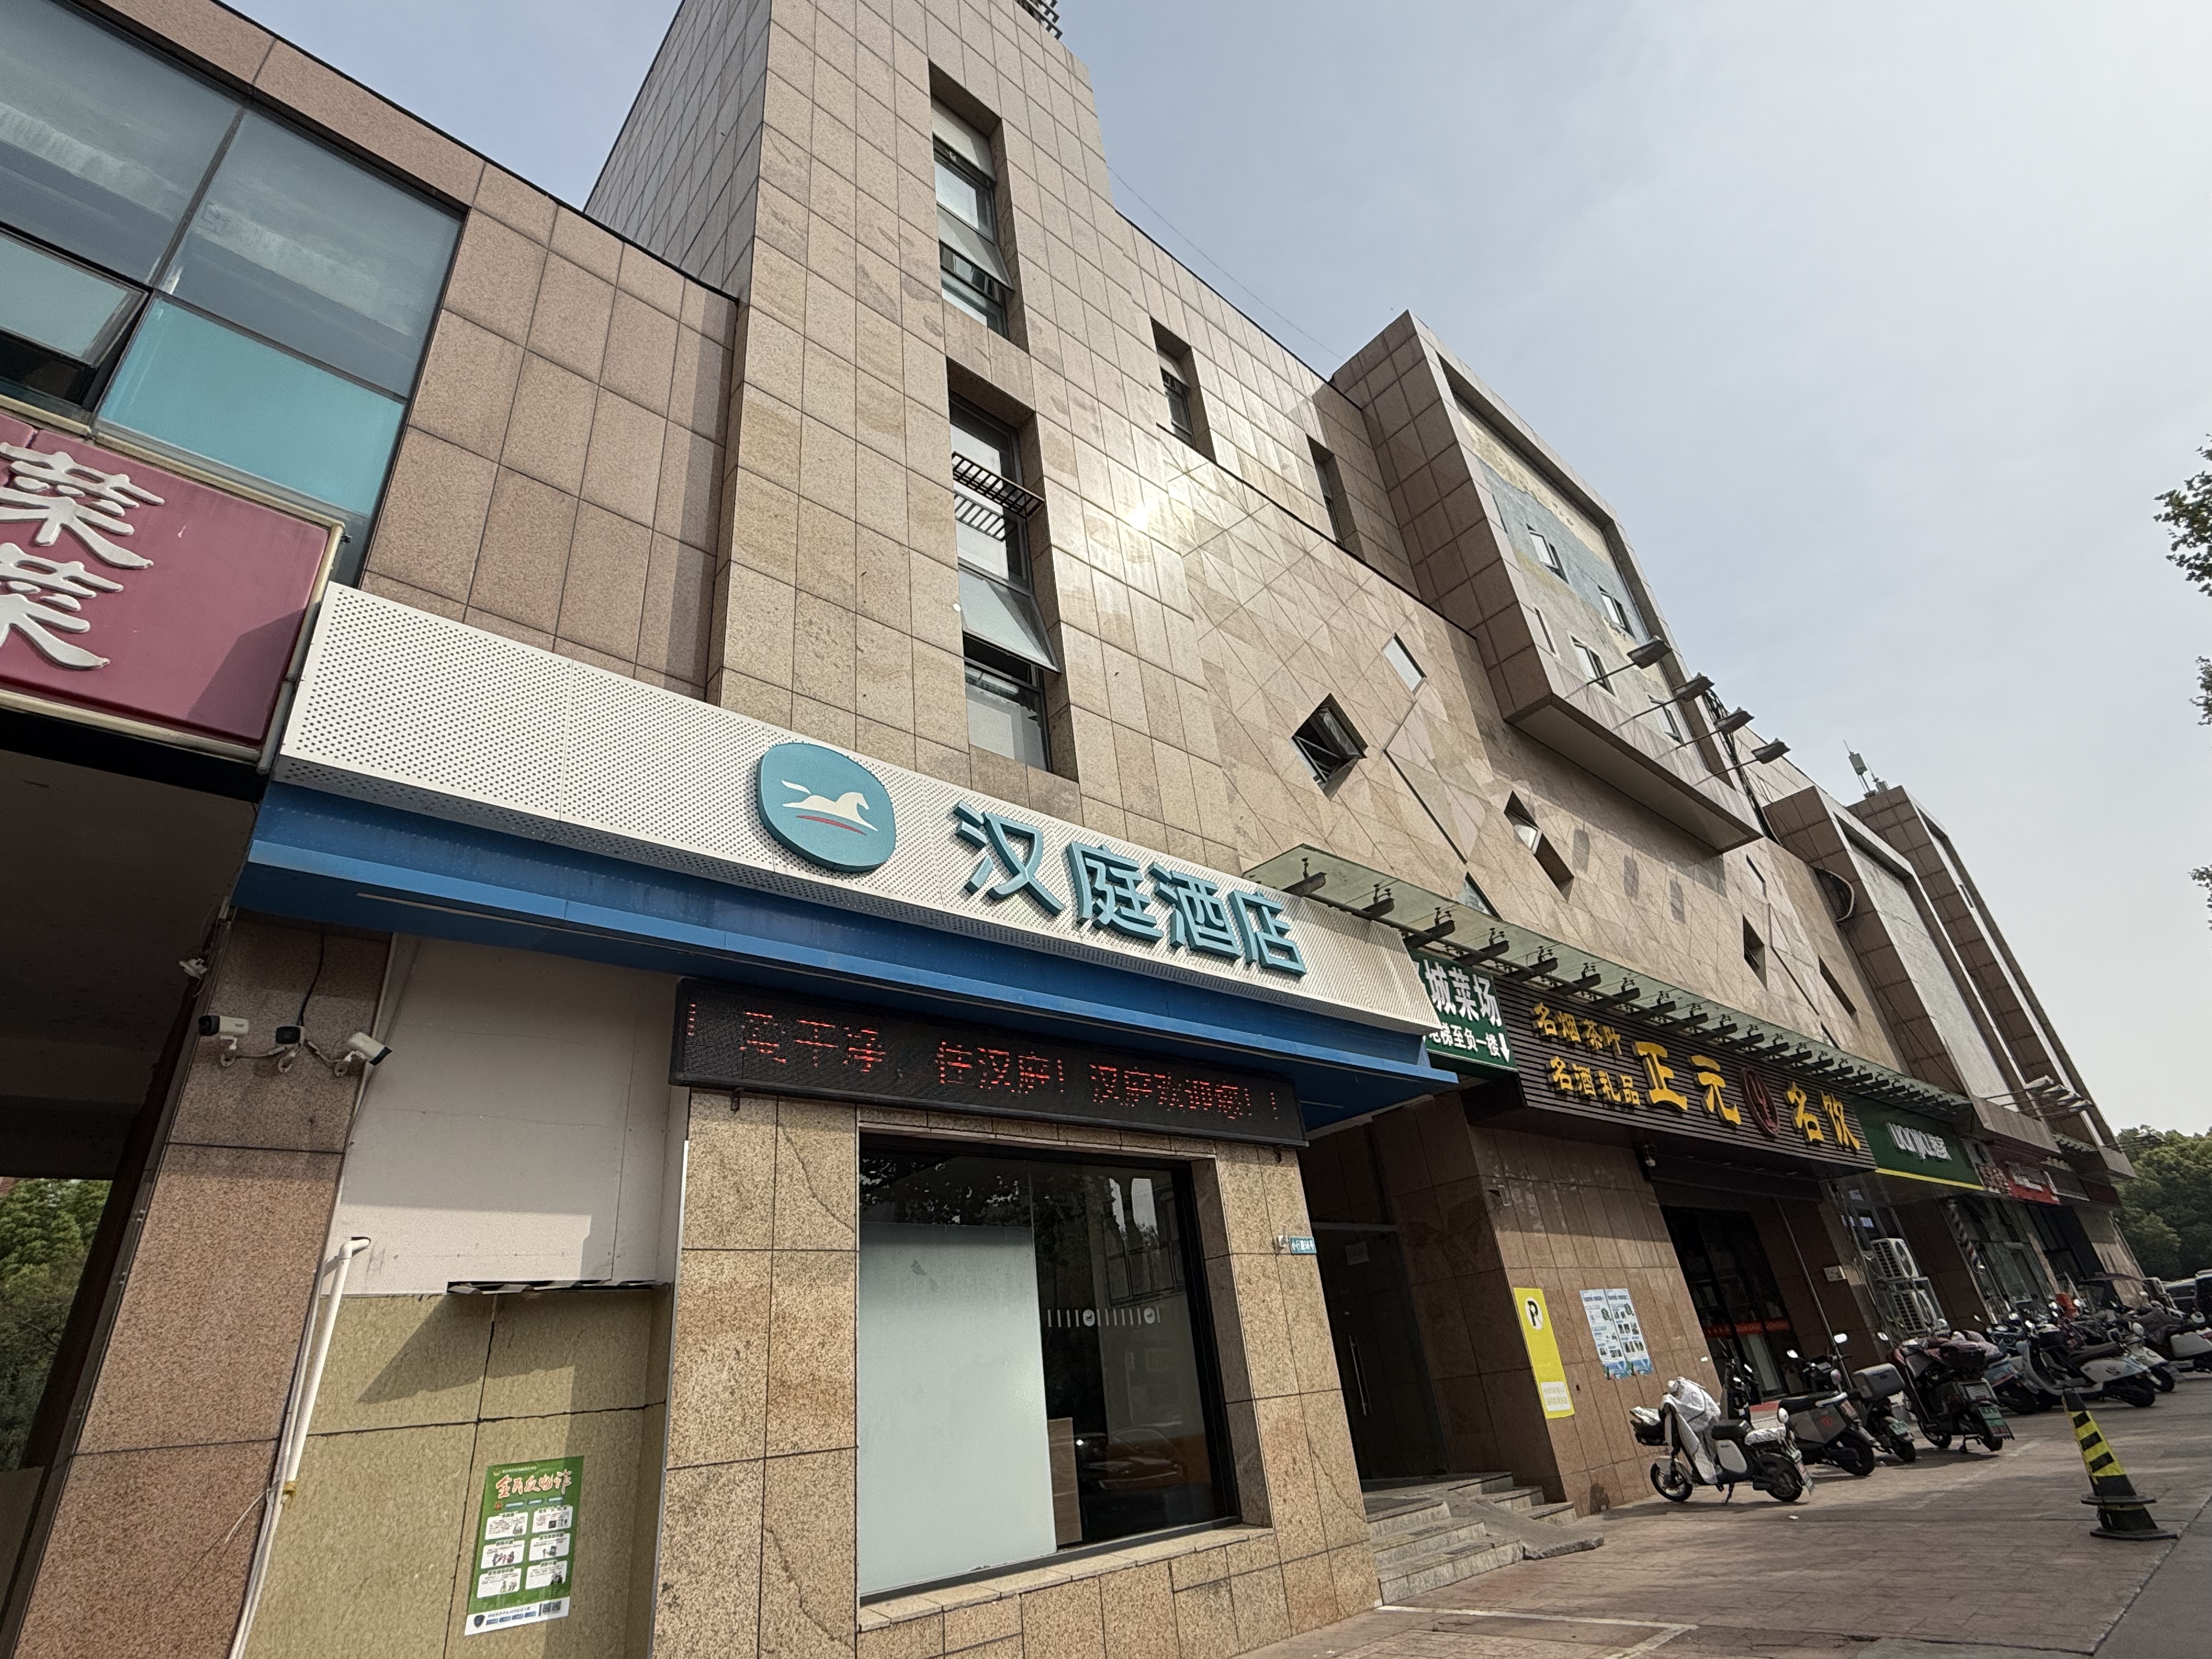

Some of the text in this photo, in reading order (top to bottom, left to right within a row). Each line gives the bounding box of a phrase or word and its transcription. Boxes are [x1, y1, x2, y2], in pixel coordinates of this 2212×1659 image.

[953, 799, 1307, 977] 汉庭酒店
[1413, 959, 1502, 1027] 城菜场
[1532, 1002, 1622, 1056] 名烟茶叶
[1548, 1056, 1641, 1106] 名酒礼品
